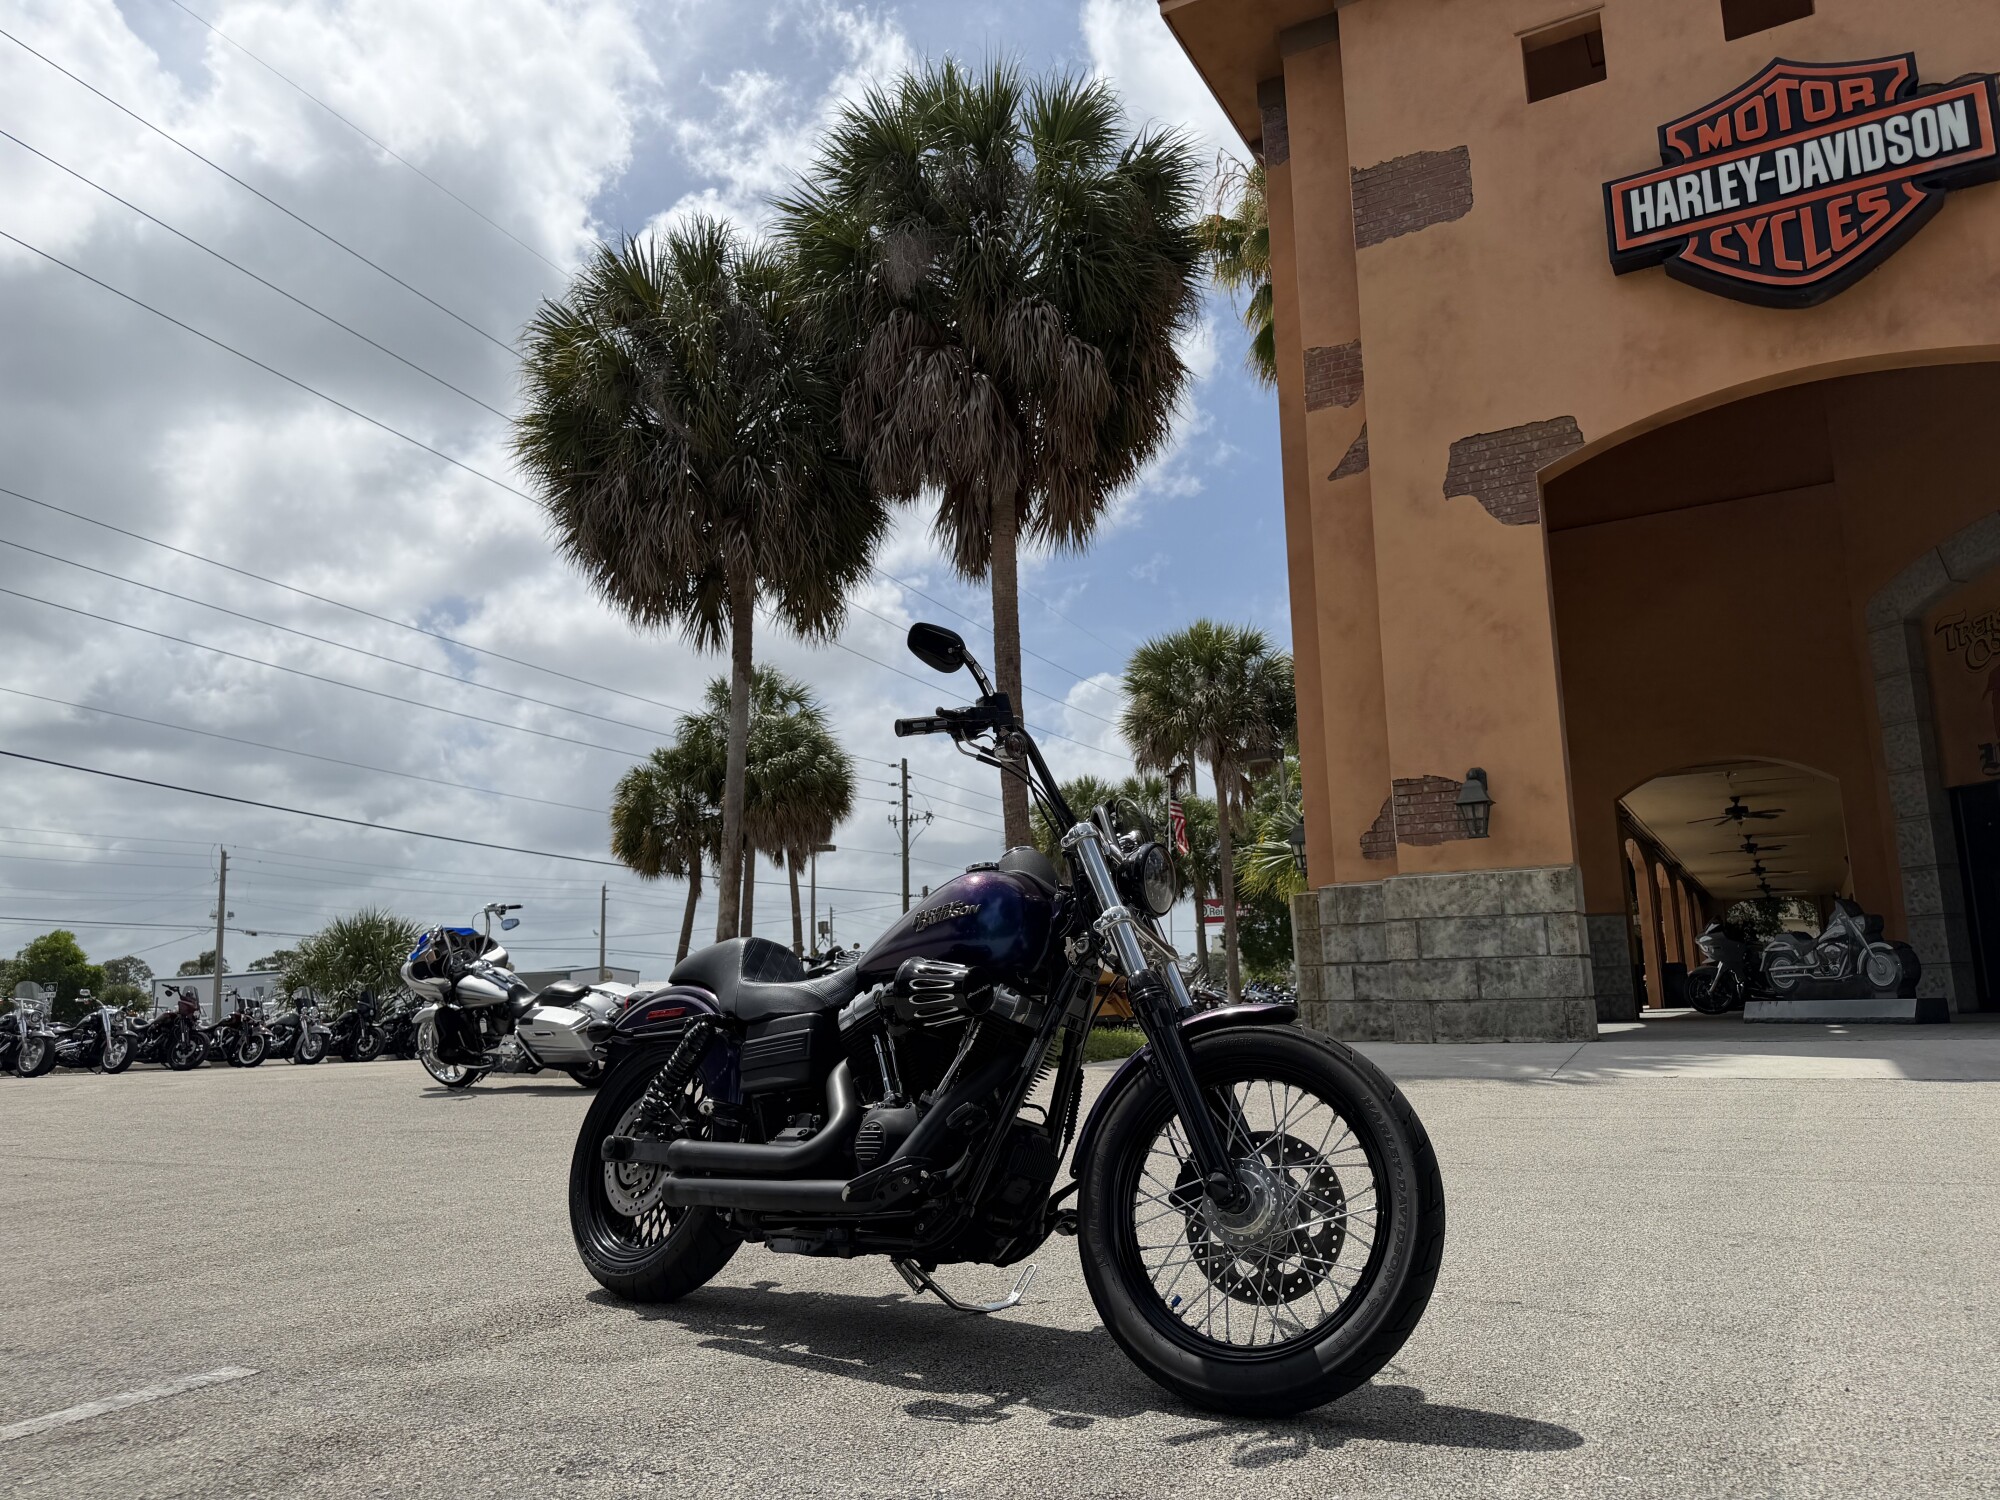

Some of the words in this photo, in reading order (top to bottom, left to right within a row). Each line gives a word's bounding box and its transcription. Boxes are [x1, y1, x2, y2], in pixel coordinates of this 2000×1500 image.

[1697, 76, 1876, 154] MOTOR
[1630, 99, 1971, 234] HARLEY-DAVIDSON
[1710, 186, 1891, 271] CYCLES
[915, 903, 982, 933] DAVIDSON
